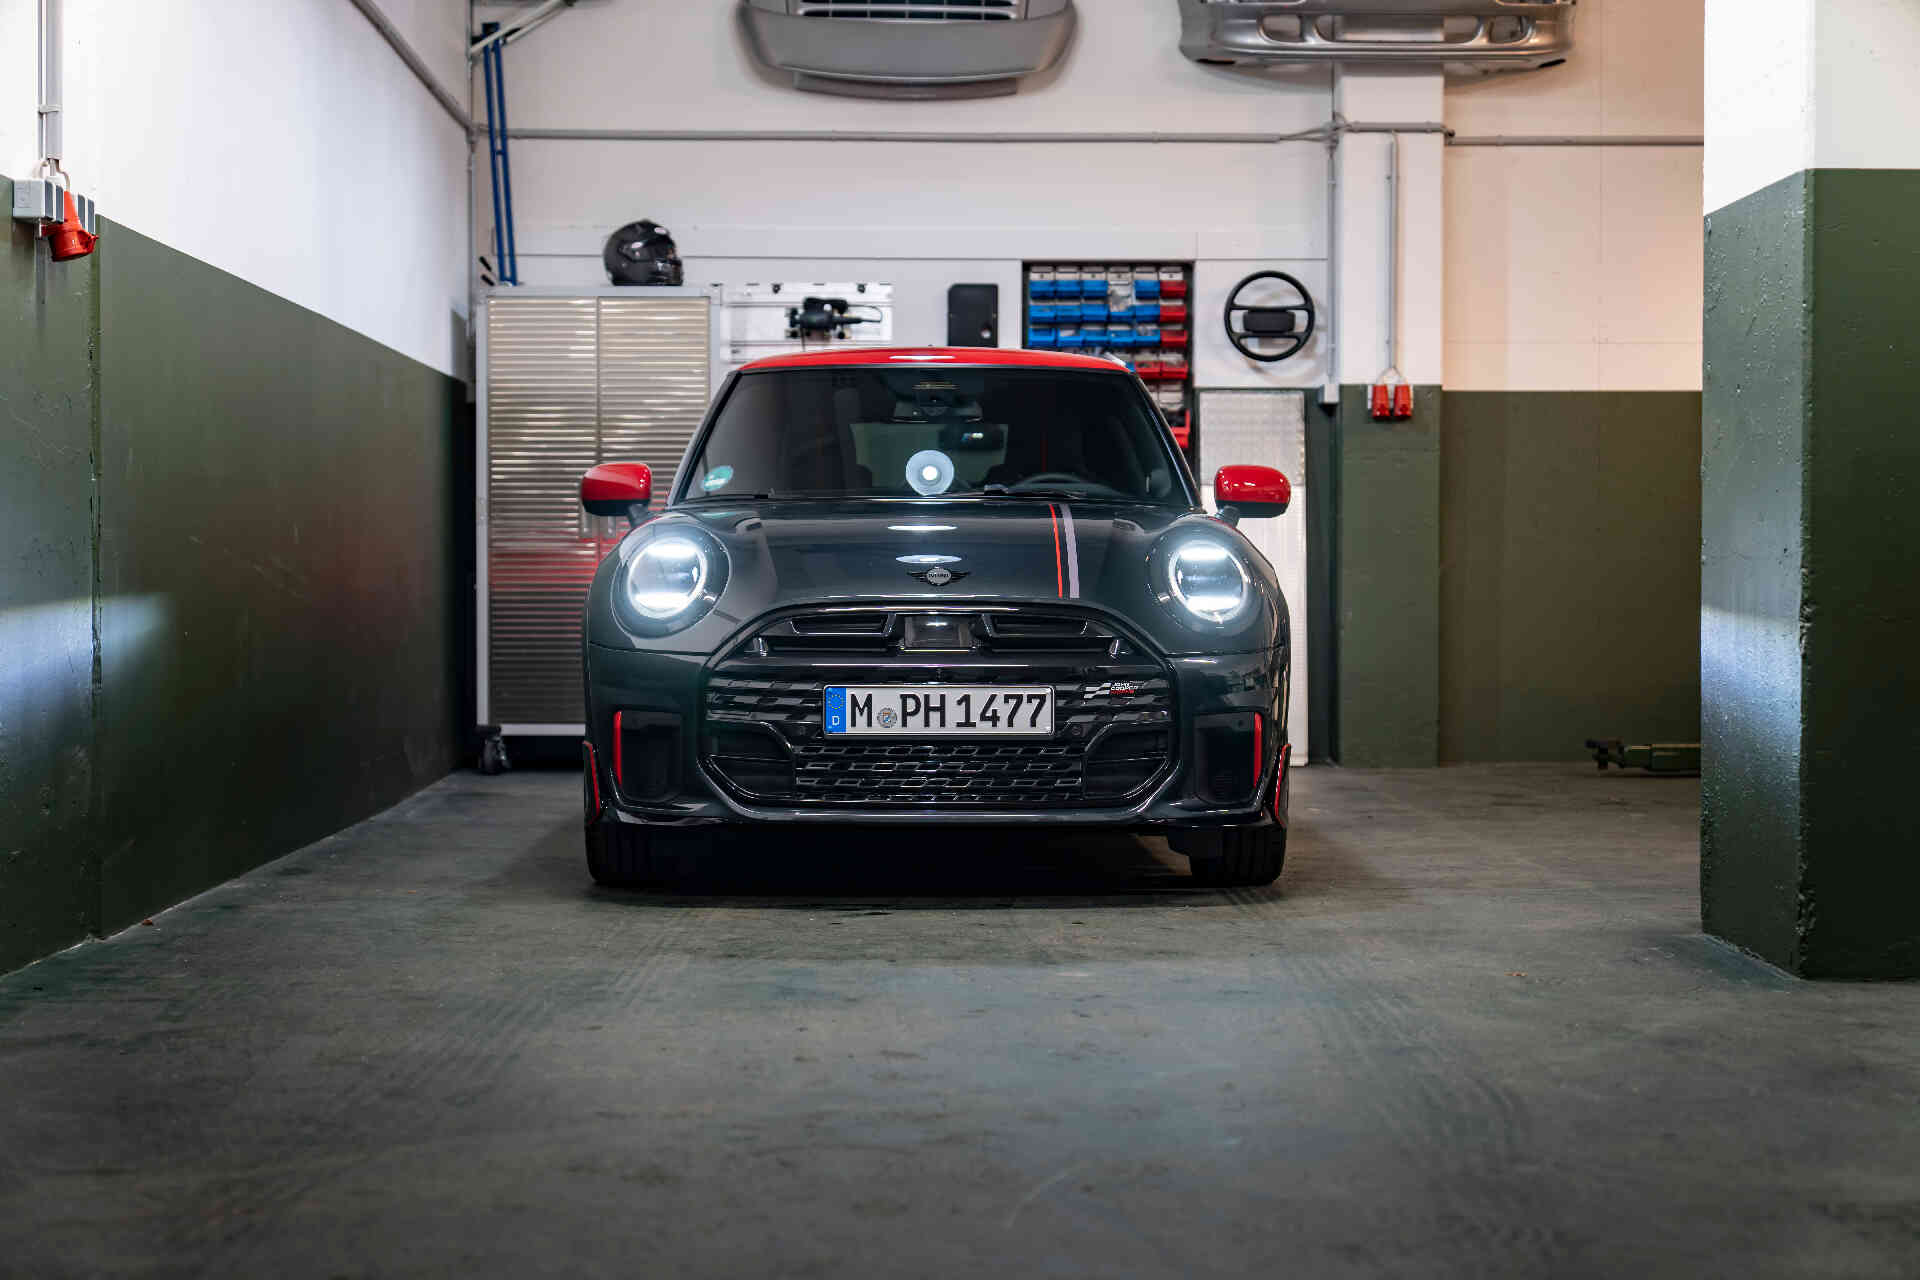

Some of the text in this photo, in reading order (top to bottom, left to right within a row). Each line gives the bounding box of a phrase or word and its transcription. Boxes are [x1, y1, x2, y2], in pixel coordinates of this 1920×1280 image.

[831, 715, 840, 726] D
[850, 693, 1047, 728] M PH 1477
